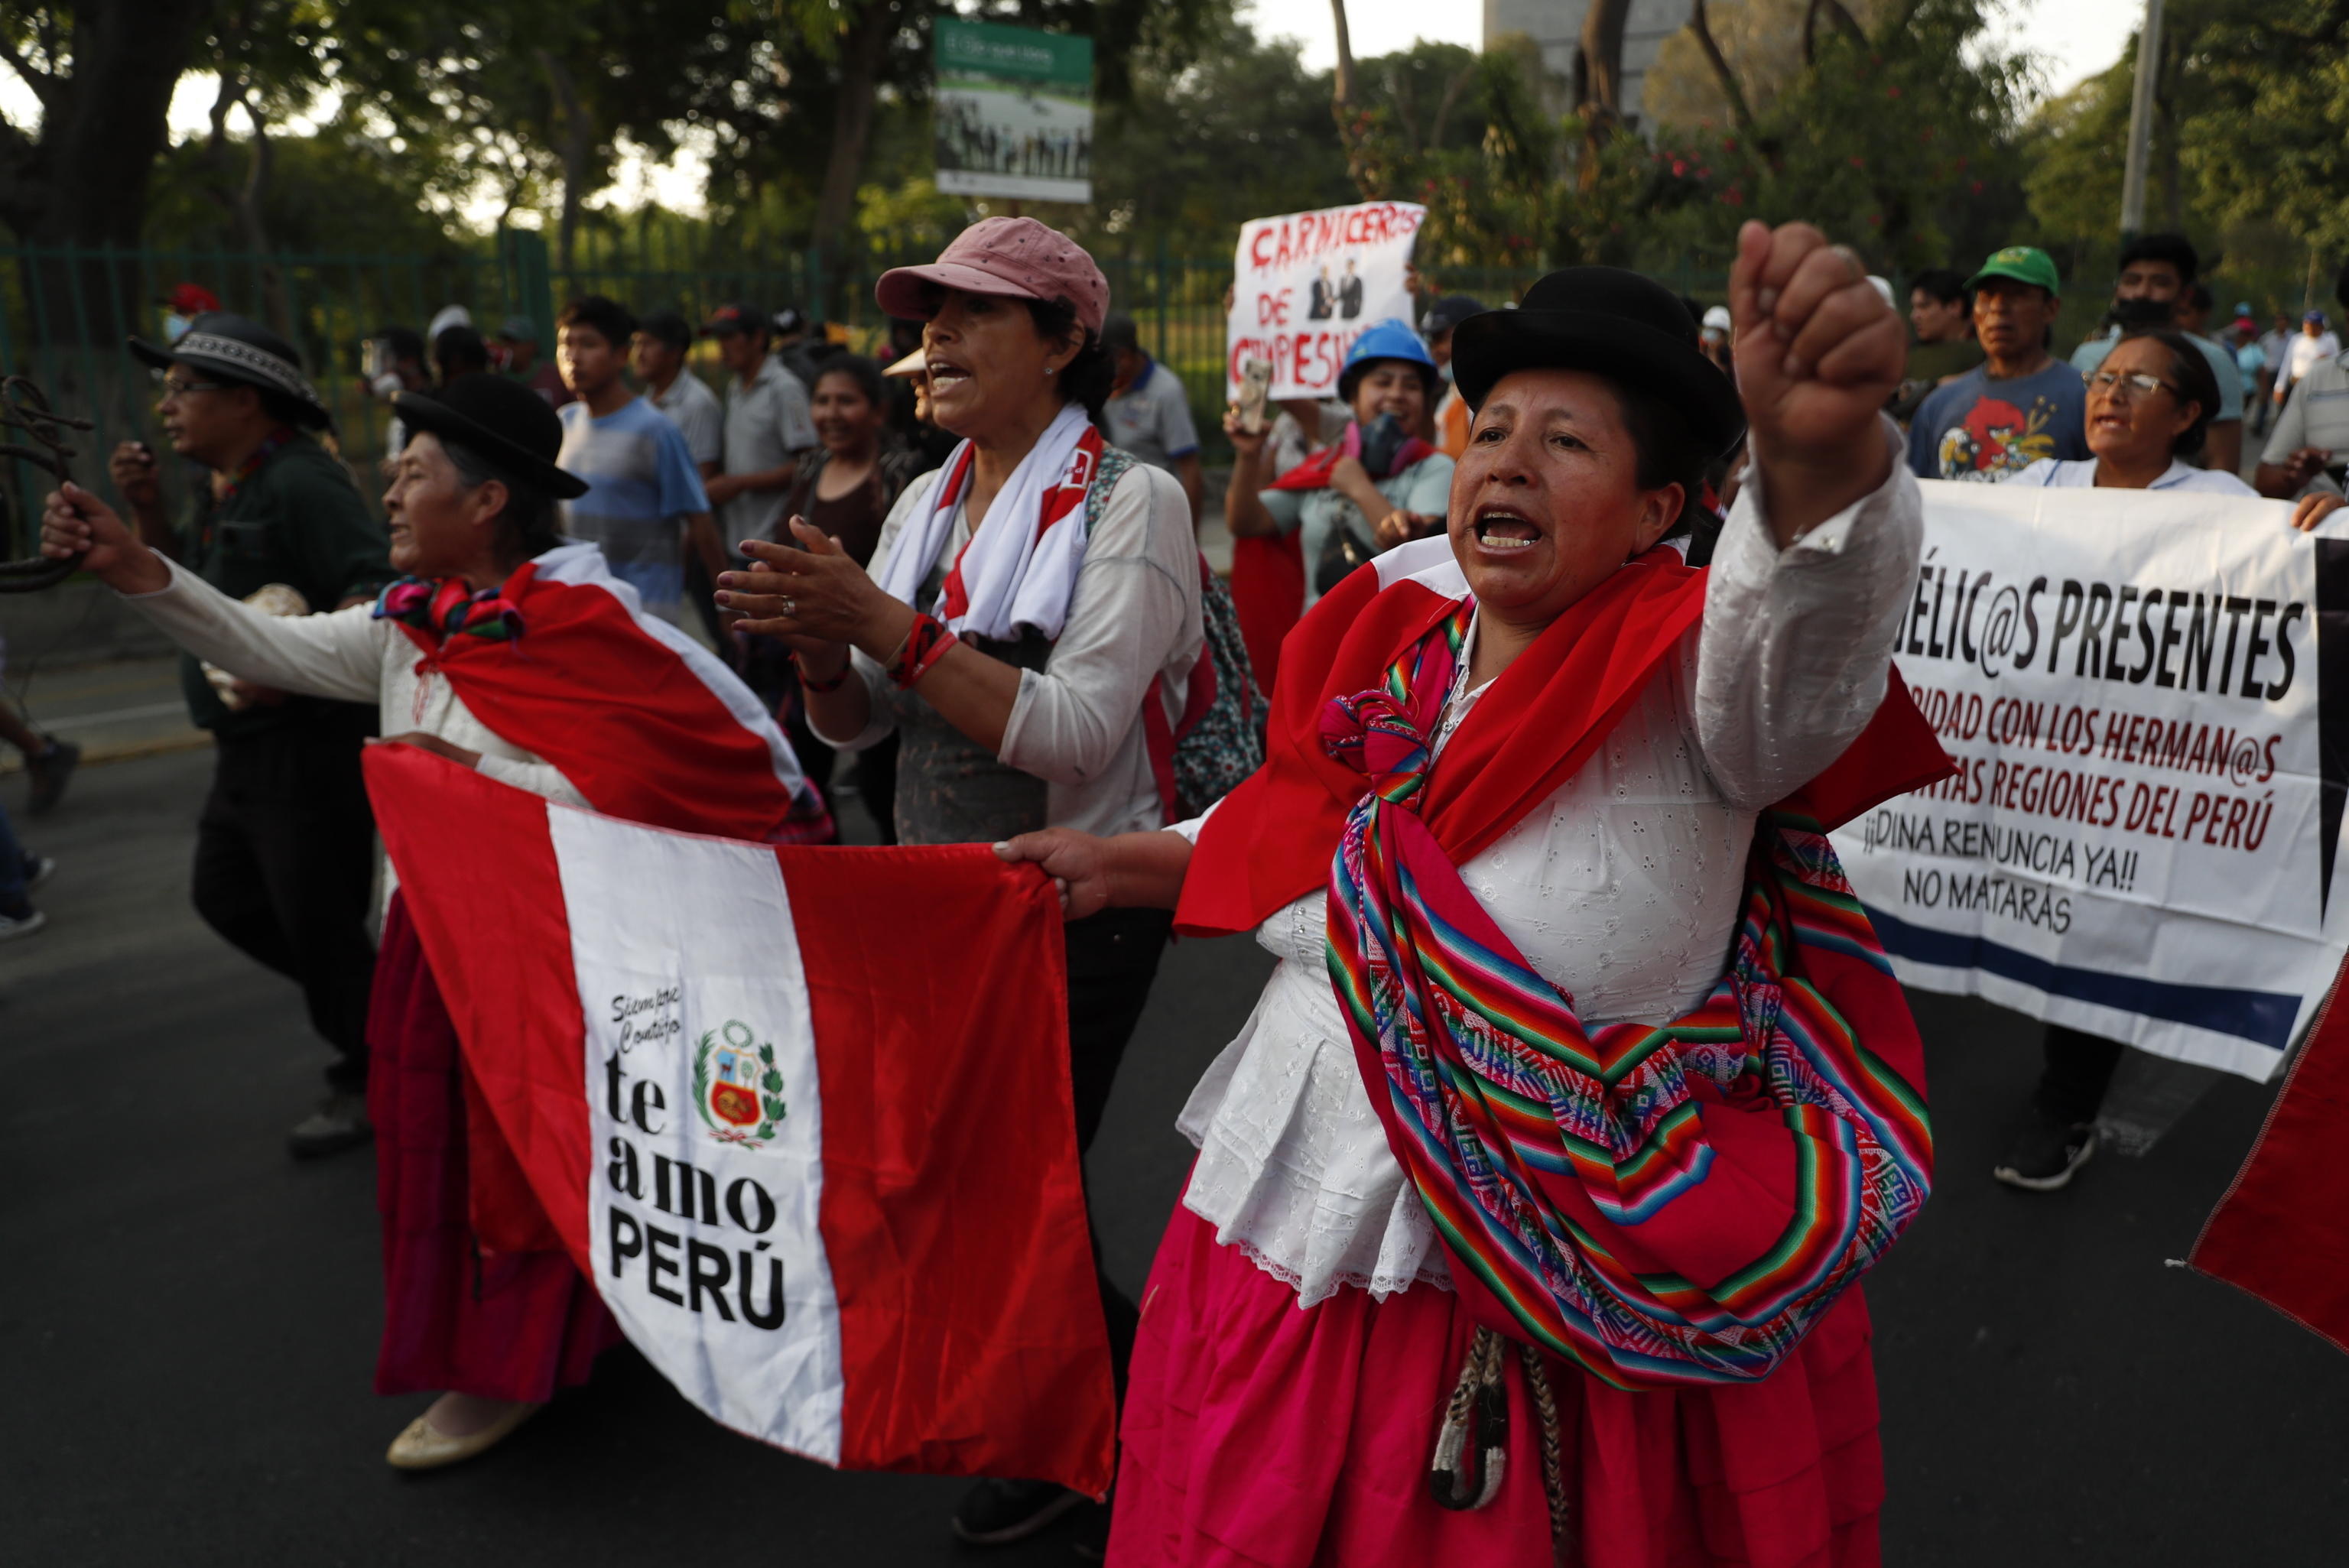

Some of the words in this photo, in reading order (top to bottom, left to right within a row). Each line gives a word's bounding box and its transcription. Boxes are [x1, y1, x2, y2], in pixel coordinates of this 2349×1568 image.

[1256, 287, 1293, 327] DE
[1893, 545, 2048, 679] ÉLIC@S
[2047, 577, 2303, 702] PRESENTES
[1987, 696, 2044, 748] CON
[2045, 703, 2100, 756] LOS
[2100, 710, 2282, 787] HERMAN@S
[1990, 758, 2126, 828] REGIONES
[2123, 780, 2181, 839] DEL
[2182, 789, 2275, 852] PERÚ
[1942, 819, 2074, 879] RENUNCIA
[2084, 843, 2139, 892] YA!!
[1903, 868, 1942, 908] NO
[1948, 872, 2071, 934] MATARÁS
[612, 986, 681, 1022] Siempre
[605, 1048, 666, 1135] te
[608, 1135, 777, 1235] amo
[609, 1203, 785, 1331] PERÚ
